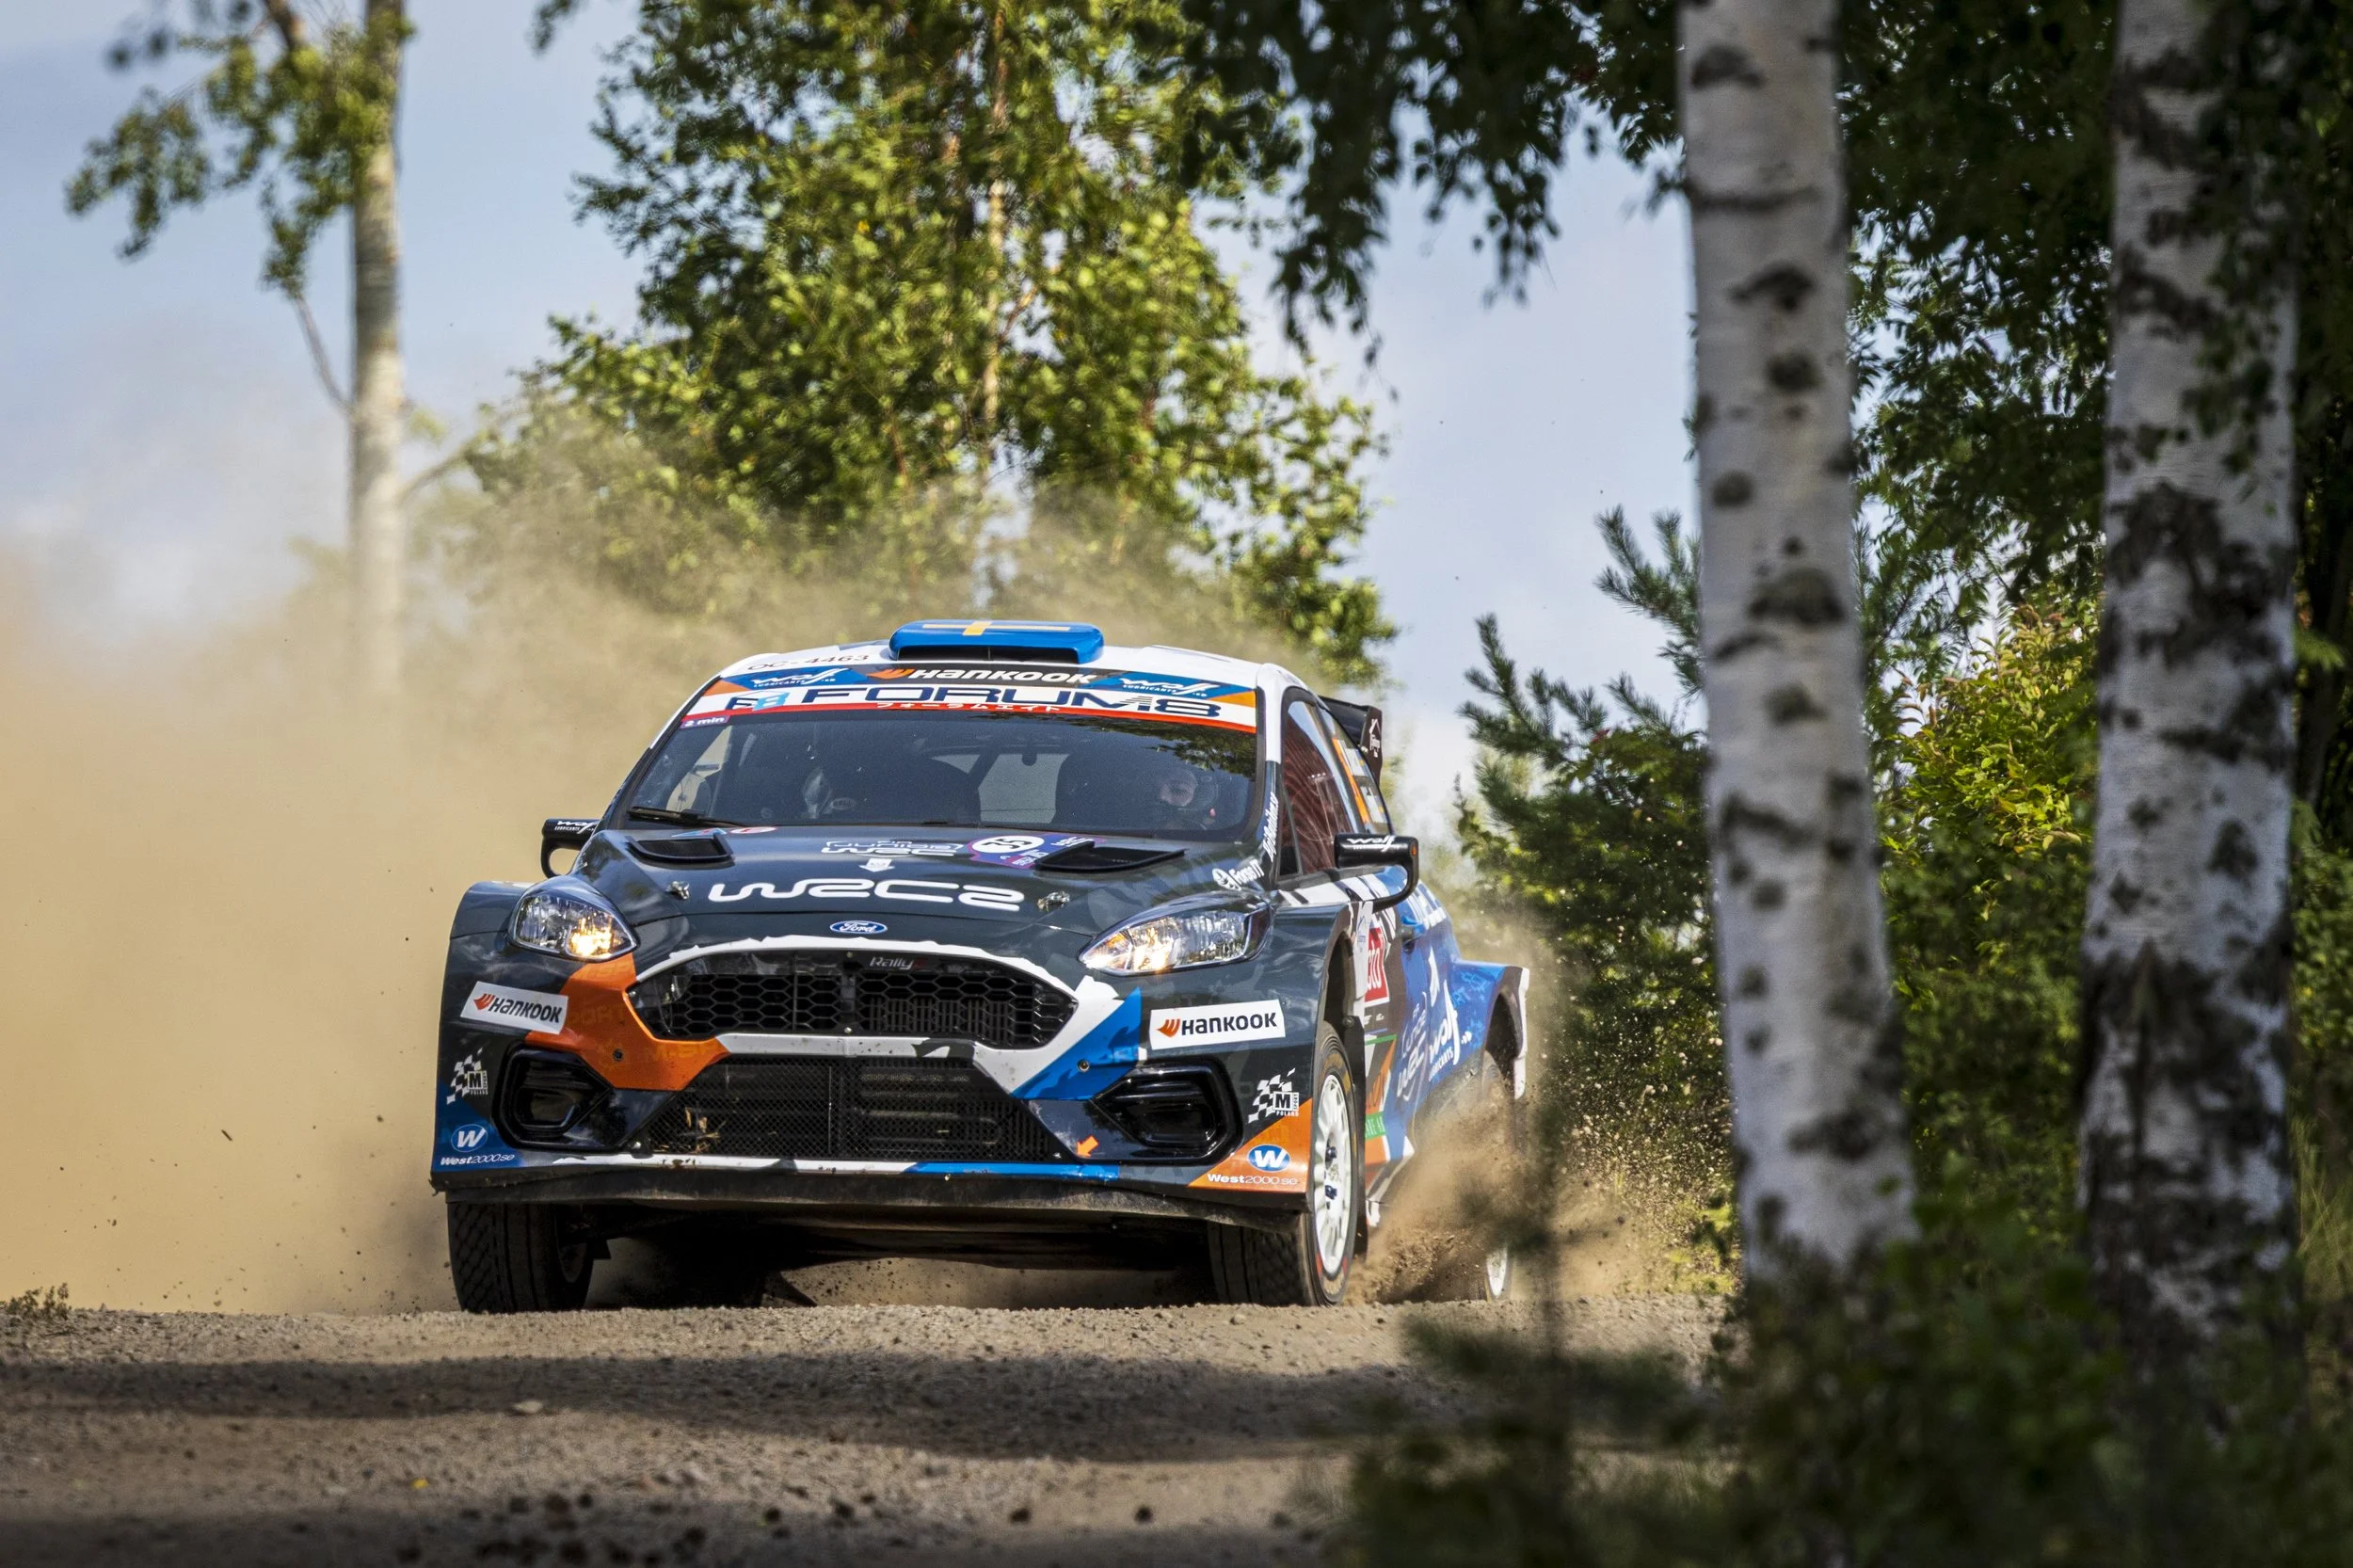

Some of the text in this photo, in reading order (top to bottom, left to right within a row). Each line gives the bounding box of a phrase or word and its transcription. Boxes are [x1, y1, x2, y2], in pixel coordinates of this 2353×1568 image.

[801, 686, 1222, 717] FORUM8
[684, 715, 726, 728] 2 min
[983, 838, 1033, 849] 35
[821, 847, 957, 856] WRC
[708, 878, 1025, 912] WRC2
[838, 920, 882, 934] Ford
[1275, 1093, 1291, 1109] M
[456, 1128, 487, 1147] W
[440, 1153, 515, 1166] West2000.se
[1254, 1149, 1288, 1168] W
[1207, 1173, 1298, 1186] West2000.se
